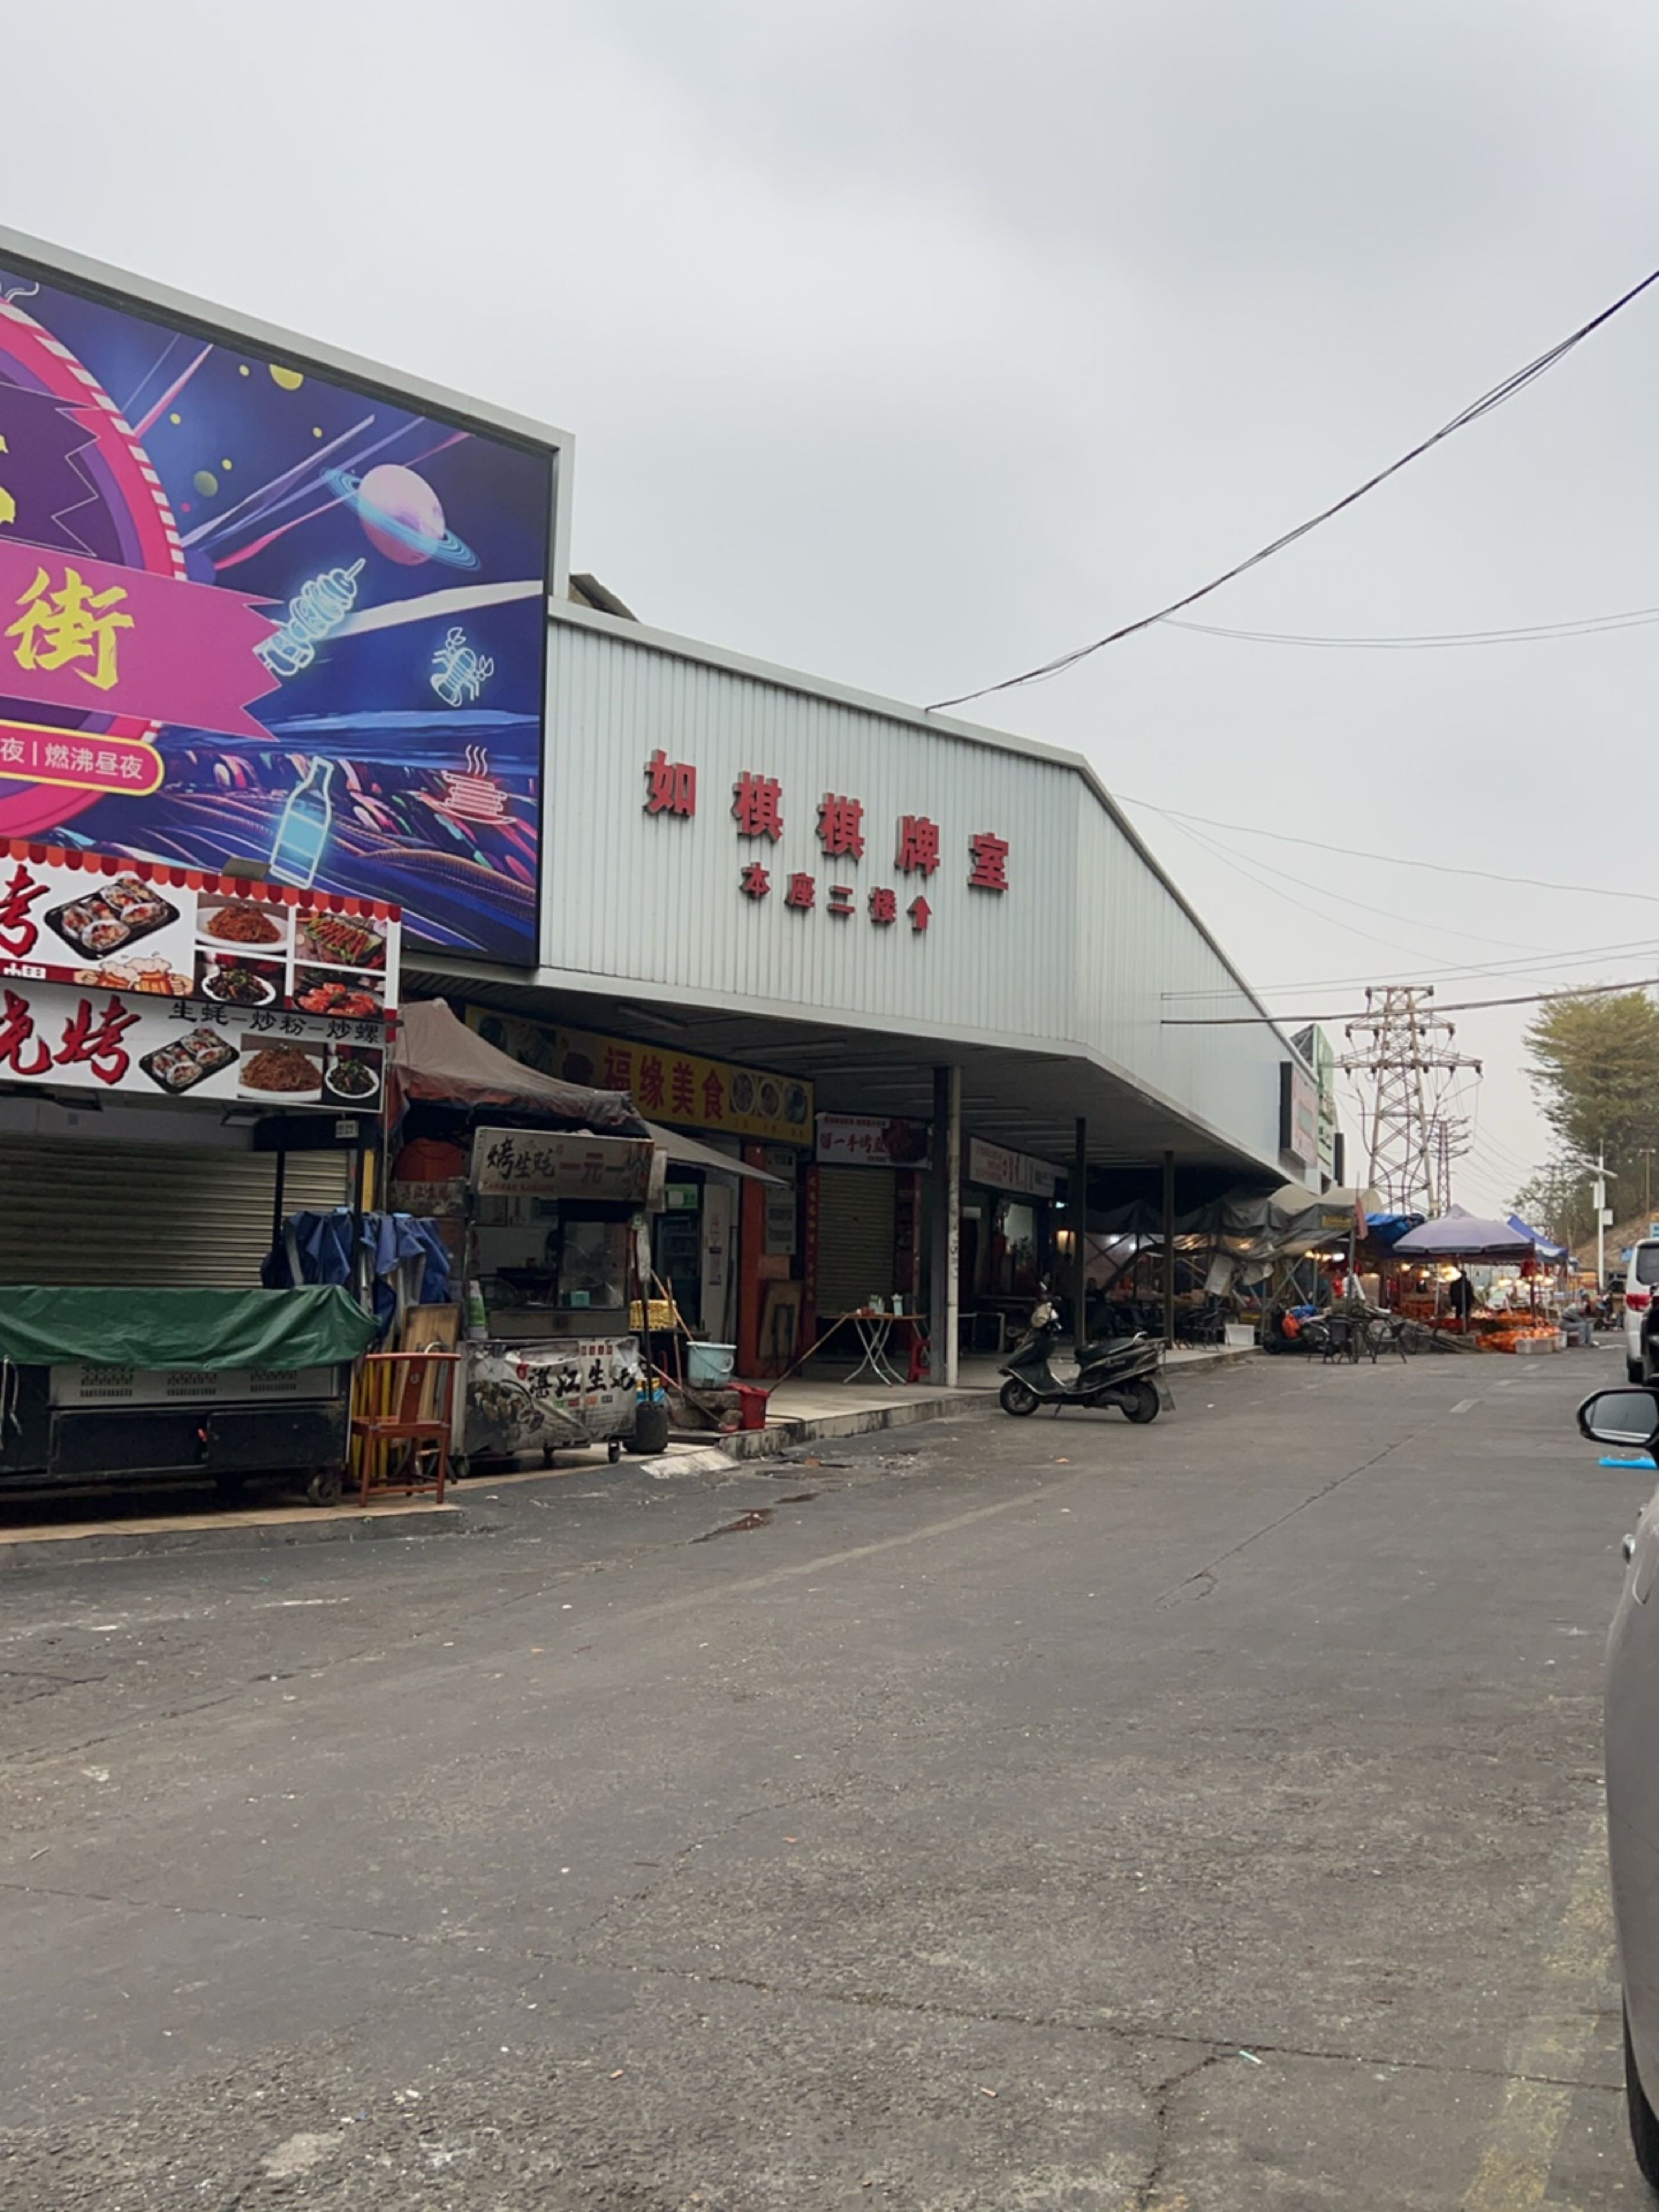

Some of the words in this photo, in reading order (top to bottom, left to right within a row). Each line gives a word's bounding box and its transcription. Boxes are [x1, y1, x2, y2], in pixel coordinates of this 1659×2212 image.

[4, 566, 134, 691] 街
[642, 749, 1009, 892] 如棋棋牌室
[741, 862, 895, 925] 本座二楼
[604, 1046, 725, 1121] 福缘美食
